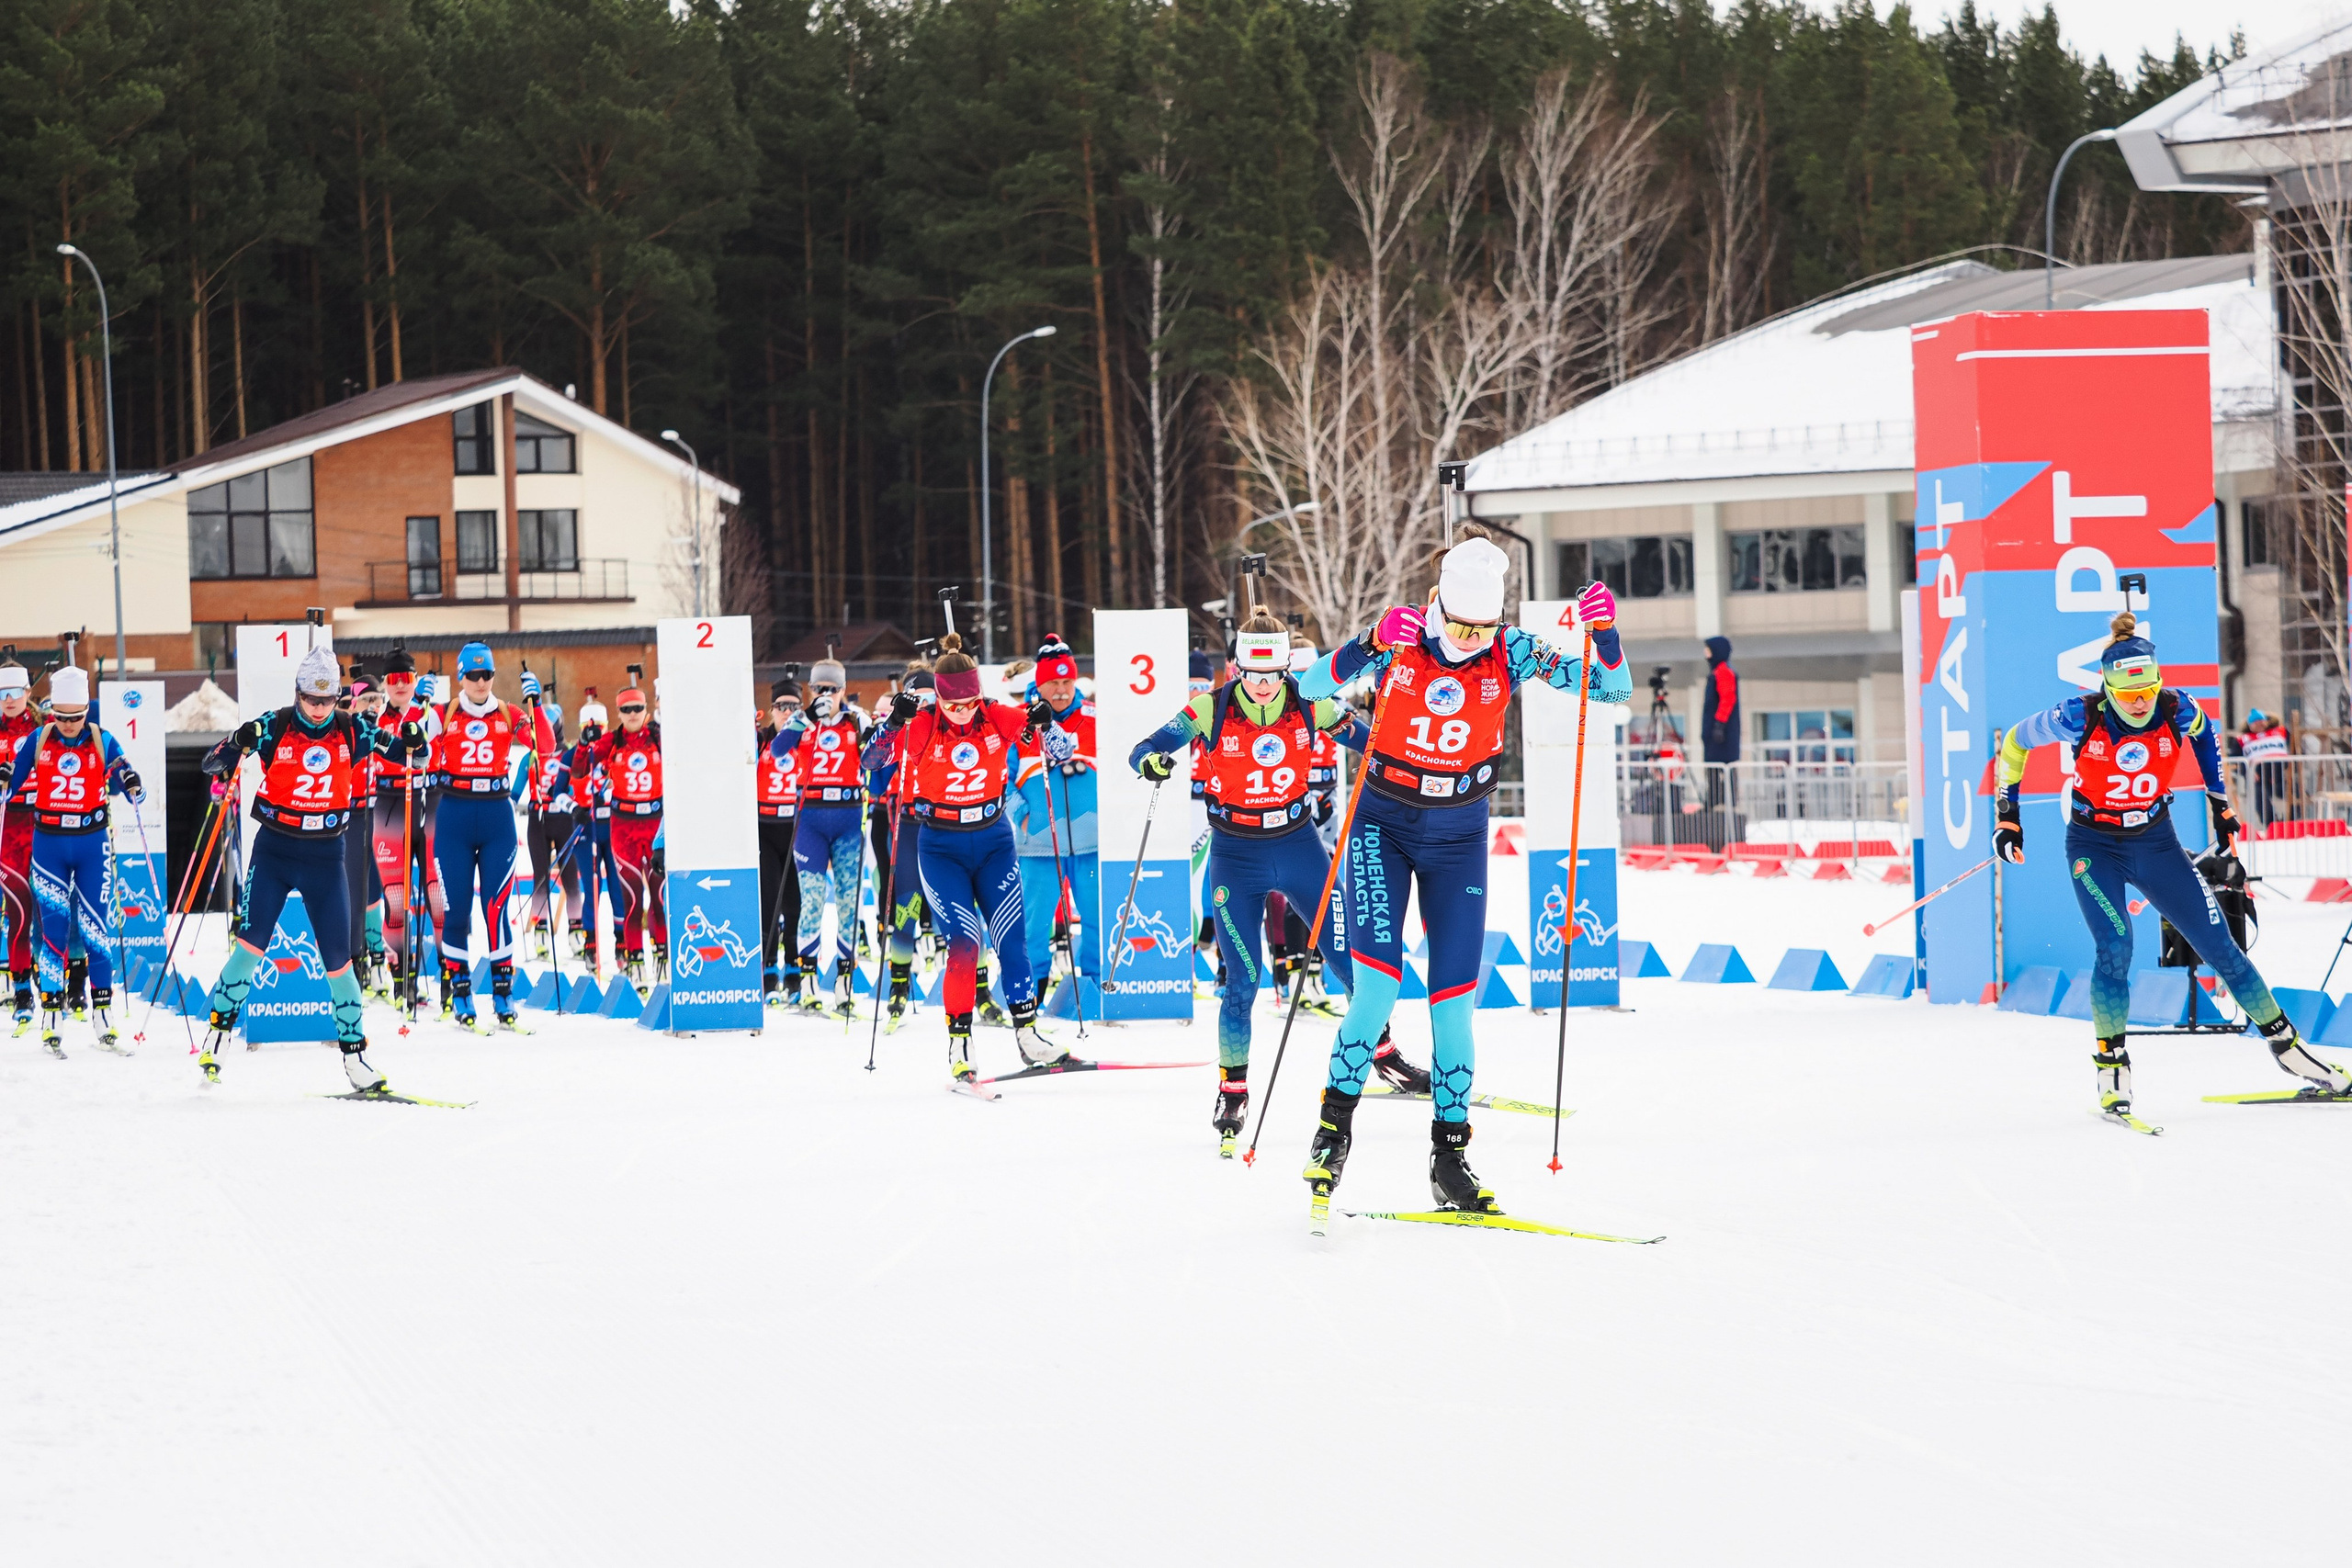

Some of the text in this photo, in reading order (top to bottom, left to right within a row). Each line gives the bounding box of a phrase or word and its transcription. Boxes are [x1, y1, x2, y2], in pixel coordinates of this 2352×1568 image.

[1558, 605, 1575, 631] 4
[276, 631, 288, 658] 1
[695, 622, 714, 648] 2
[2052, 470, 2150, 825] АРТ
[1129, 654, 1156, 694] 3
[1934, 478, 1972, 851] СТАРТ
[126, 717, 137, 739] 1
[1406, 716, 1471, 753] 18
[460, 740, 494, 764] 26
[812, 751, 845, 774] 27
[1405, 750, 1463, 767] КРАСНОЯРСК
[50, 775, 85, 801] 25
[292, 774, 334, 799] 21
[625, 772, 652, 792] 39
[767, 773, 797, 794] 31
[944, 768, 988, 793] 22
[1245, 767, 1295, 795] 19
[2105, 773, 2158, 799] 20
[290, 799, 330, 808] КРАСНОЯРСК
[945, 793, 985, 802] КРАСНОЯРСК
[99, 841, 113, 905] ЯМАЛ
[1351, 836, 1370, 928] ОБЛАСТЬ
[1364, 823, 1392, 944] ТЮМЕНСКАЯ
[2080, 872, 2125, 937] БЕЛОРУСНЕФТЬ
[1219, 906, 1258, 983] БЕЛОРУСНЕФТЬ
[673, 988, 762, 1006] КРАСНОЯРСК
[1103, 979, 1192, 996] РАСНОЯРСК
[2269, 1020, 2285, 1032] 170
[349, 1043, 360, 1051] 171
[1505, 1100, 1555, 1116] FISCHER
[1446, 1134, 1462, 1143] 168
[1455, 1213, 1485, 1223] FISCHER
